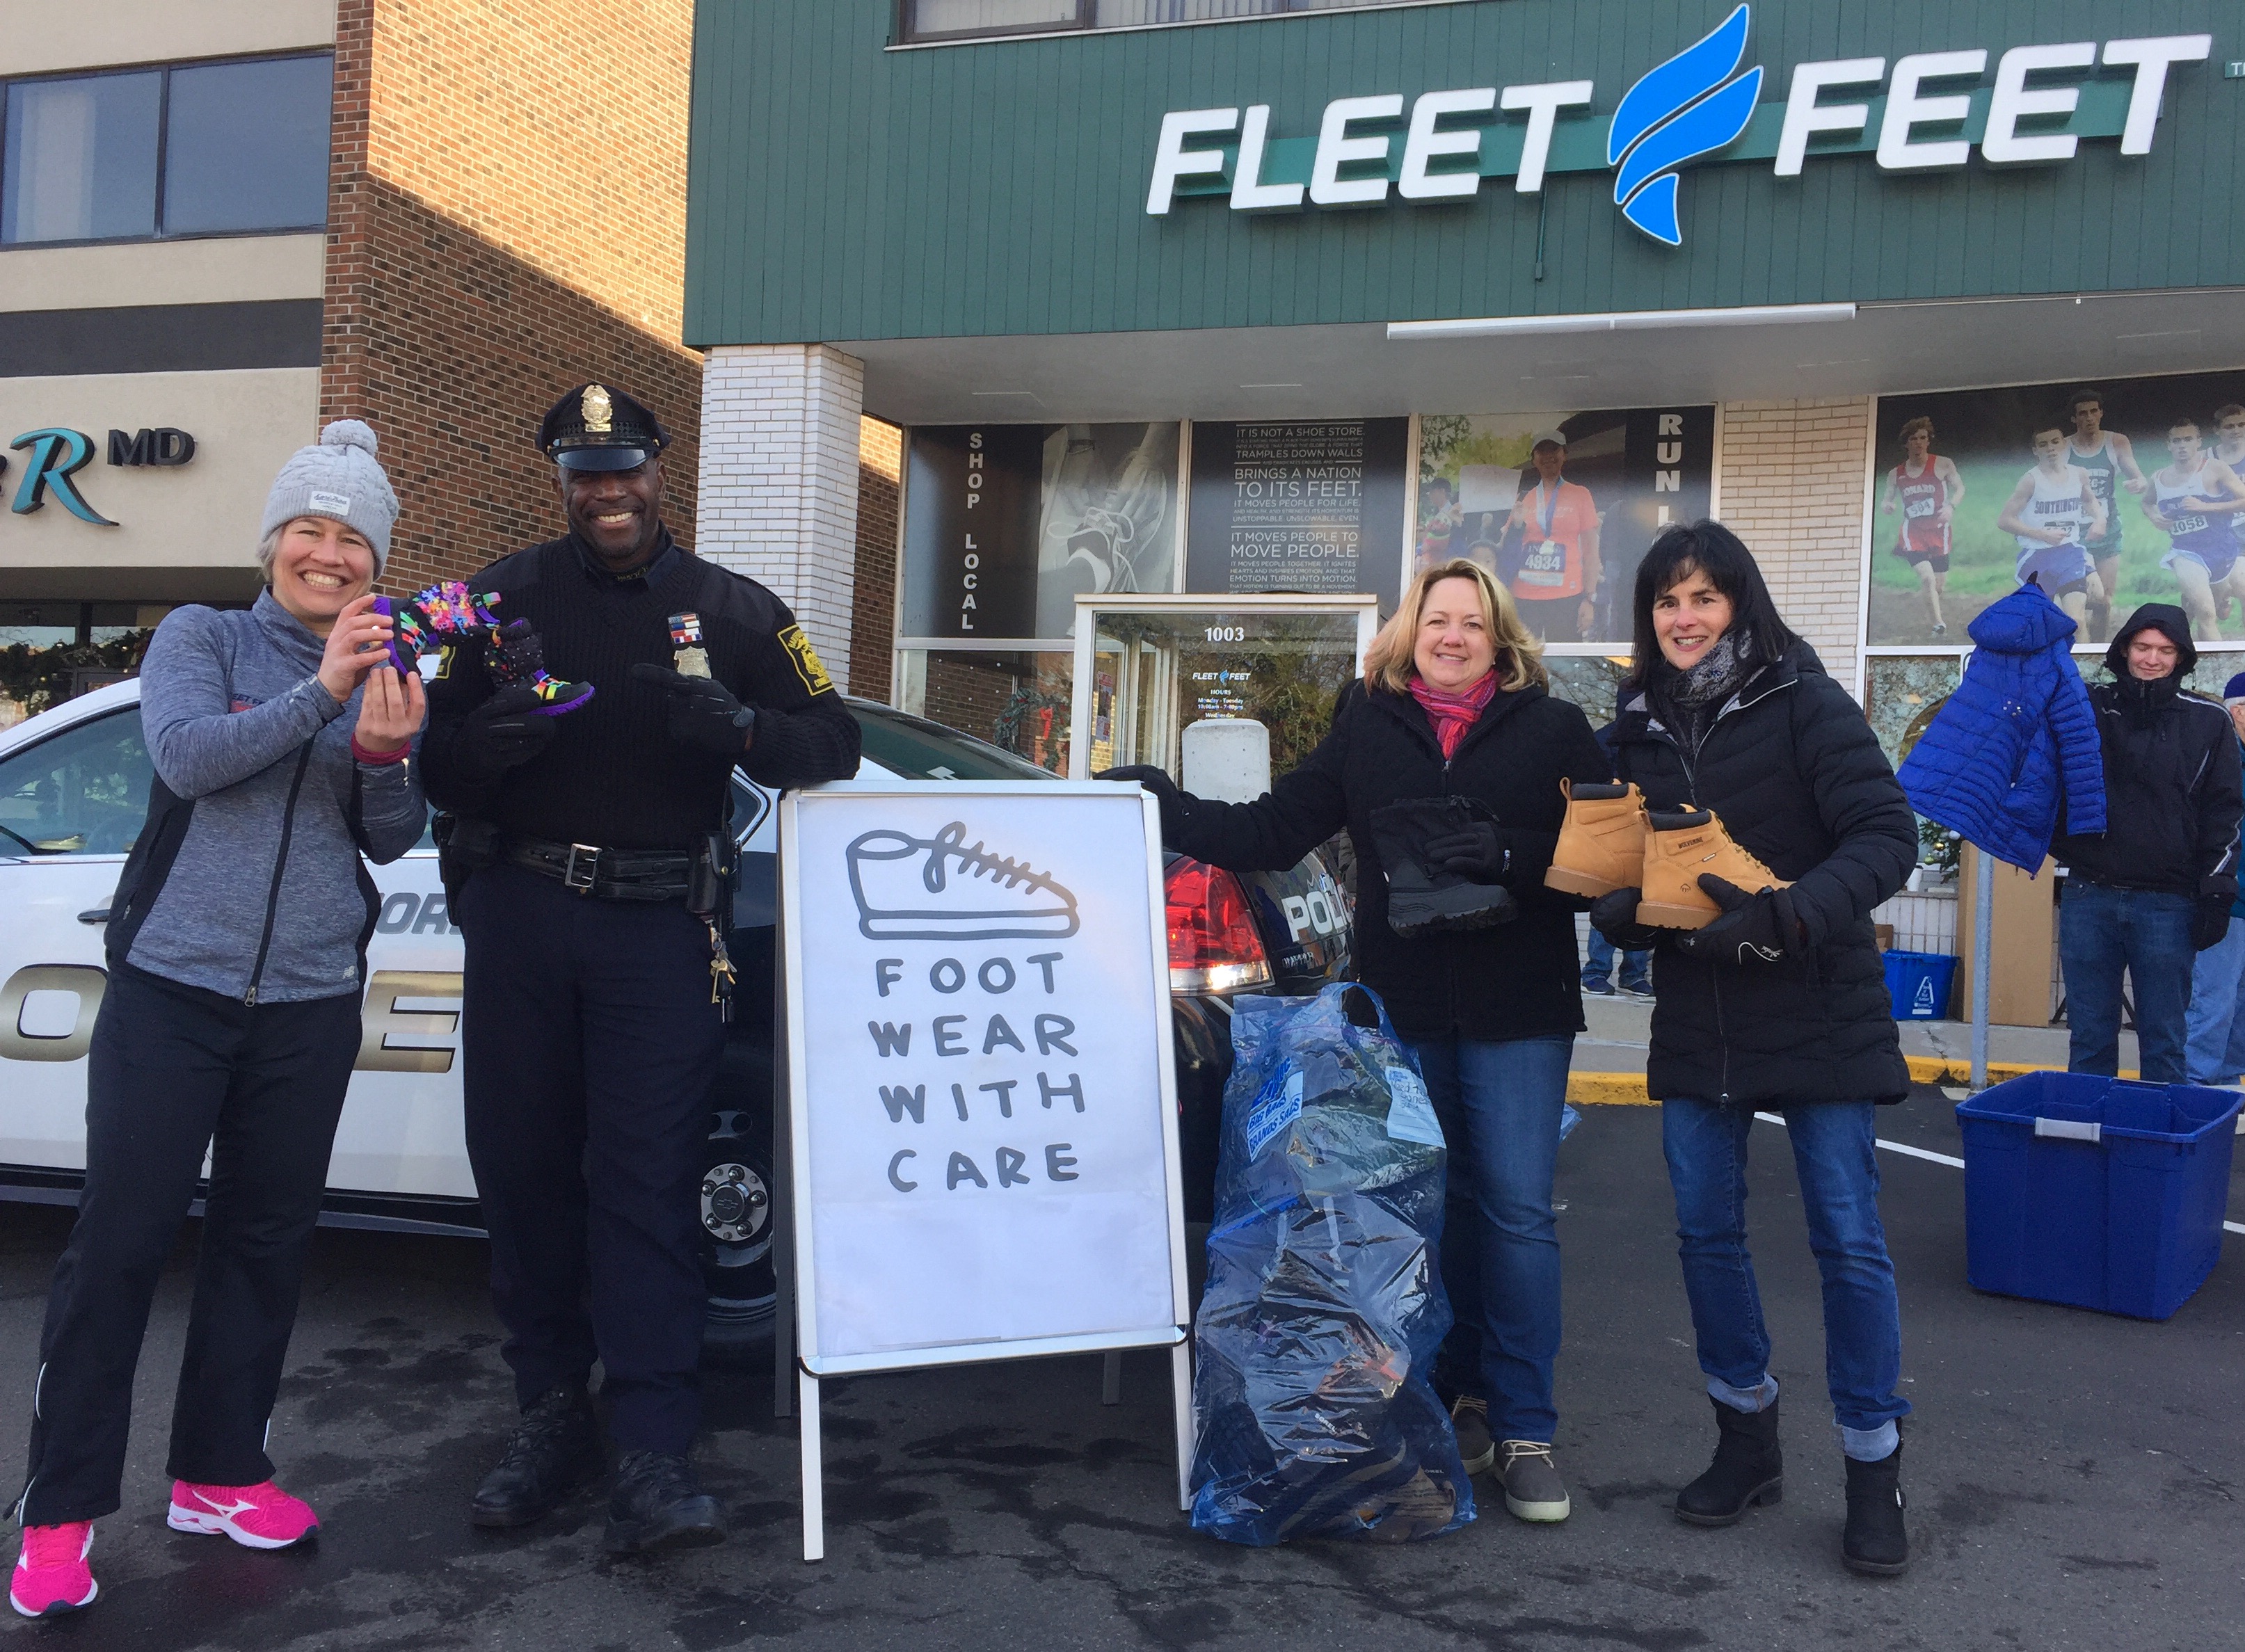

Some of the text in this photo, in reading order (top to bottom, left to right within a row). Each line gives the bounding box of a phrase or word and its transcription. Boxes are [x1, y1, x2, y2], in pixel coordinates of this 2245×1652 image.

[2230, 62, 2245, 76] T
[1146, 33, 2213, 217] FLEET FEET
[1236, 429, 1245, 438] IT
[1249, 428, 1258, 438] IS
[1261, 428, 1283, 437] NOT
[1286, 428, 1293, 437] A
[1296, 428, 1325, 436] SHOE
[107, 427, 195, 467] MD
[1236, 449, 1363, 458] TRAMPLES DOWN WALLS
[1655, 414, 1684, 492] RUN
[1235, 467, 1361, 479] BRINGS A NATION
[1234, 481, 1361, 497] TO ITS FEET.
[961, 433, 984, 629] SHOP LOCAL
[2173, 515, 2205, 534] 1058
[1231, 532, 1358, 542] IT MOVES PEOPLE TO
[1231, 544, 1359, 558] MOVE PEOPLE.
[1204, 627, 1245, 642] 1003
[1192, 672, 1219, 680] FLEET
[1677, 836, 1704, 849] WOLVERINE
[877, 952, 1064, 997] FOOT
[868, 1013, 1079, 1059] WEAR
[878, 1072, 1086, 1125] WITH
[1249, 1092, 1286, 1130] BIG BAGS
[1279, 1098, 1300, 1125] SACS
[887, 1143, 1080, 1193] CARE
[1314, 1413, 1336, 1433] SOREL
